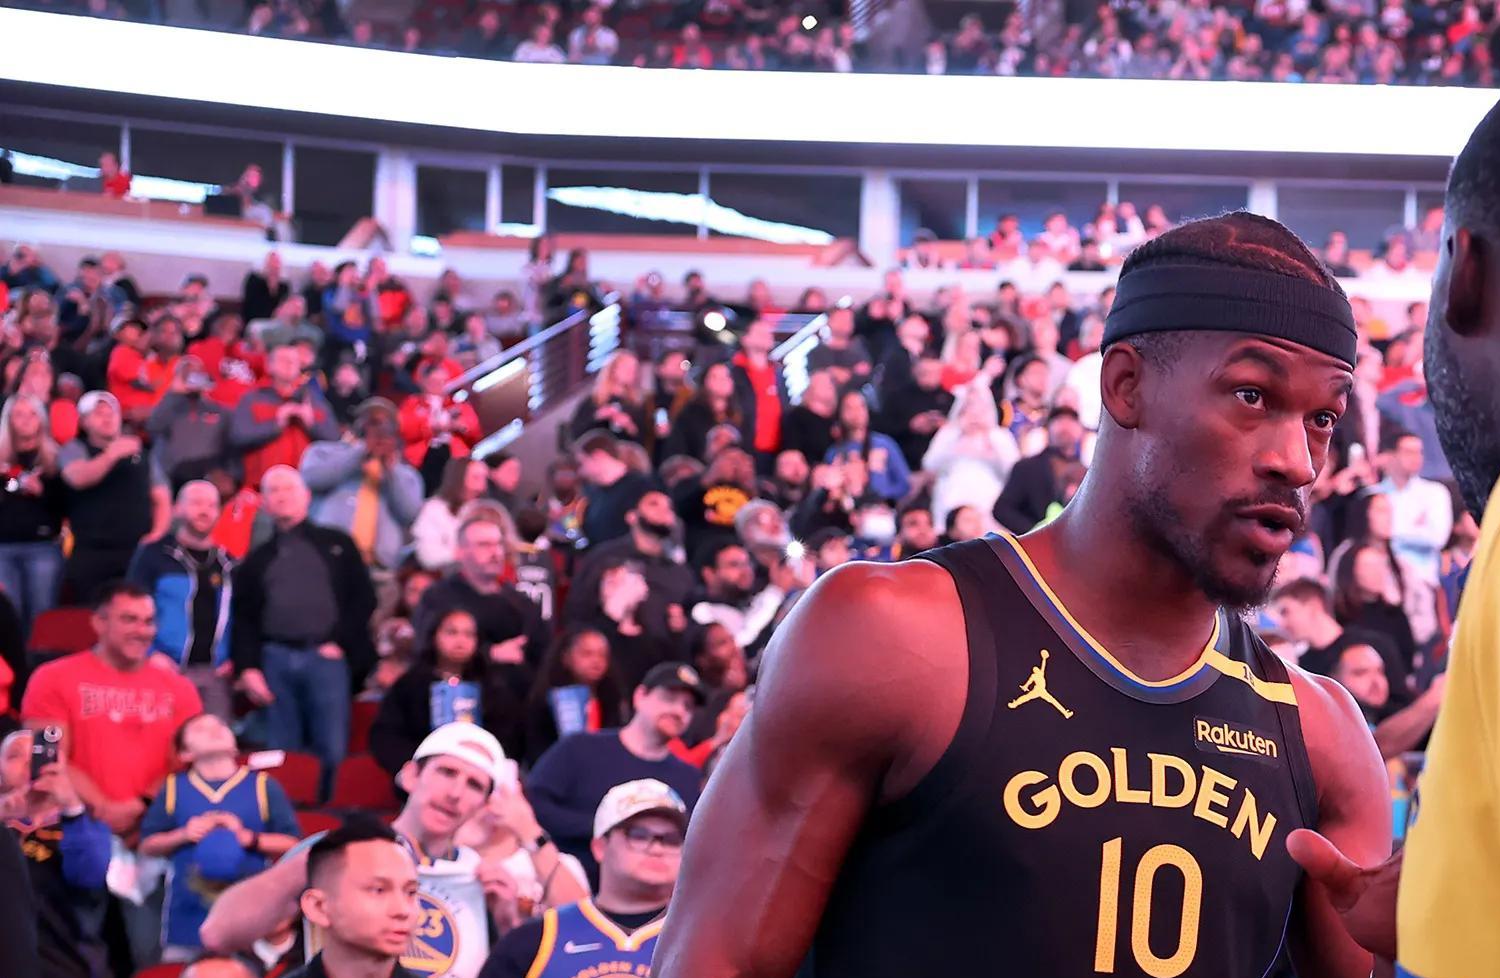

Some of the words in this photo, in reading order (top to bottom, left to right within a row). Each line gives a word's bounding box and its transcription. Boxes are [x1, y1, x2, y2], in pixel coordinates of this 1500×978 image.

[1196, 719, 1278, 758] Rakuten
[1003, 747, 1277, 861] GOLDEN
[1094, 836, 1202, 978] 10
